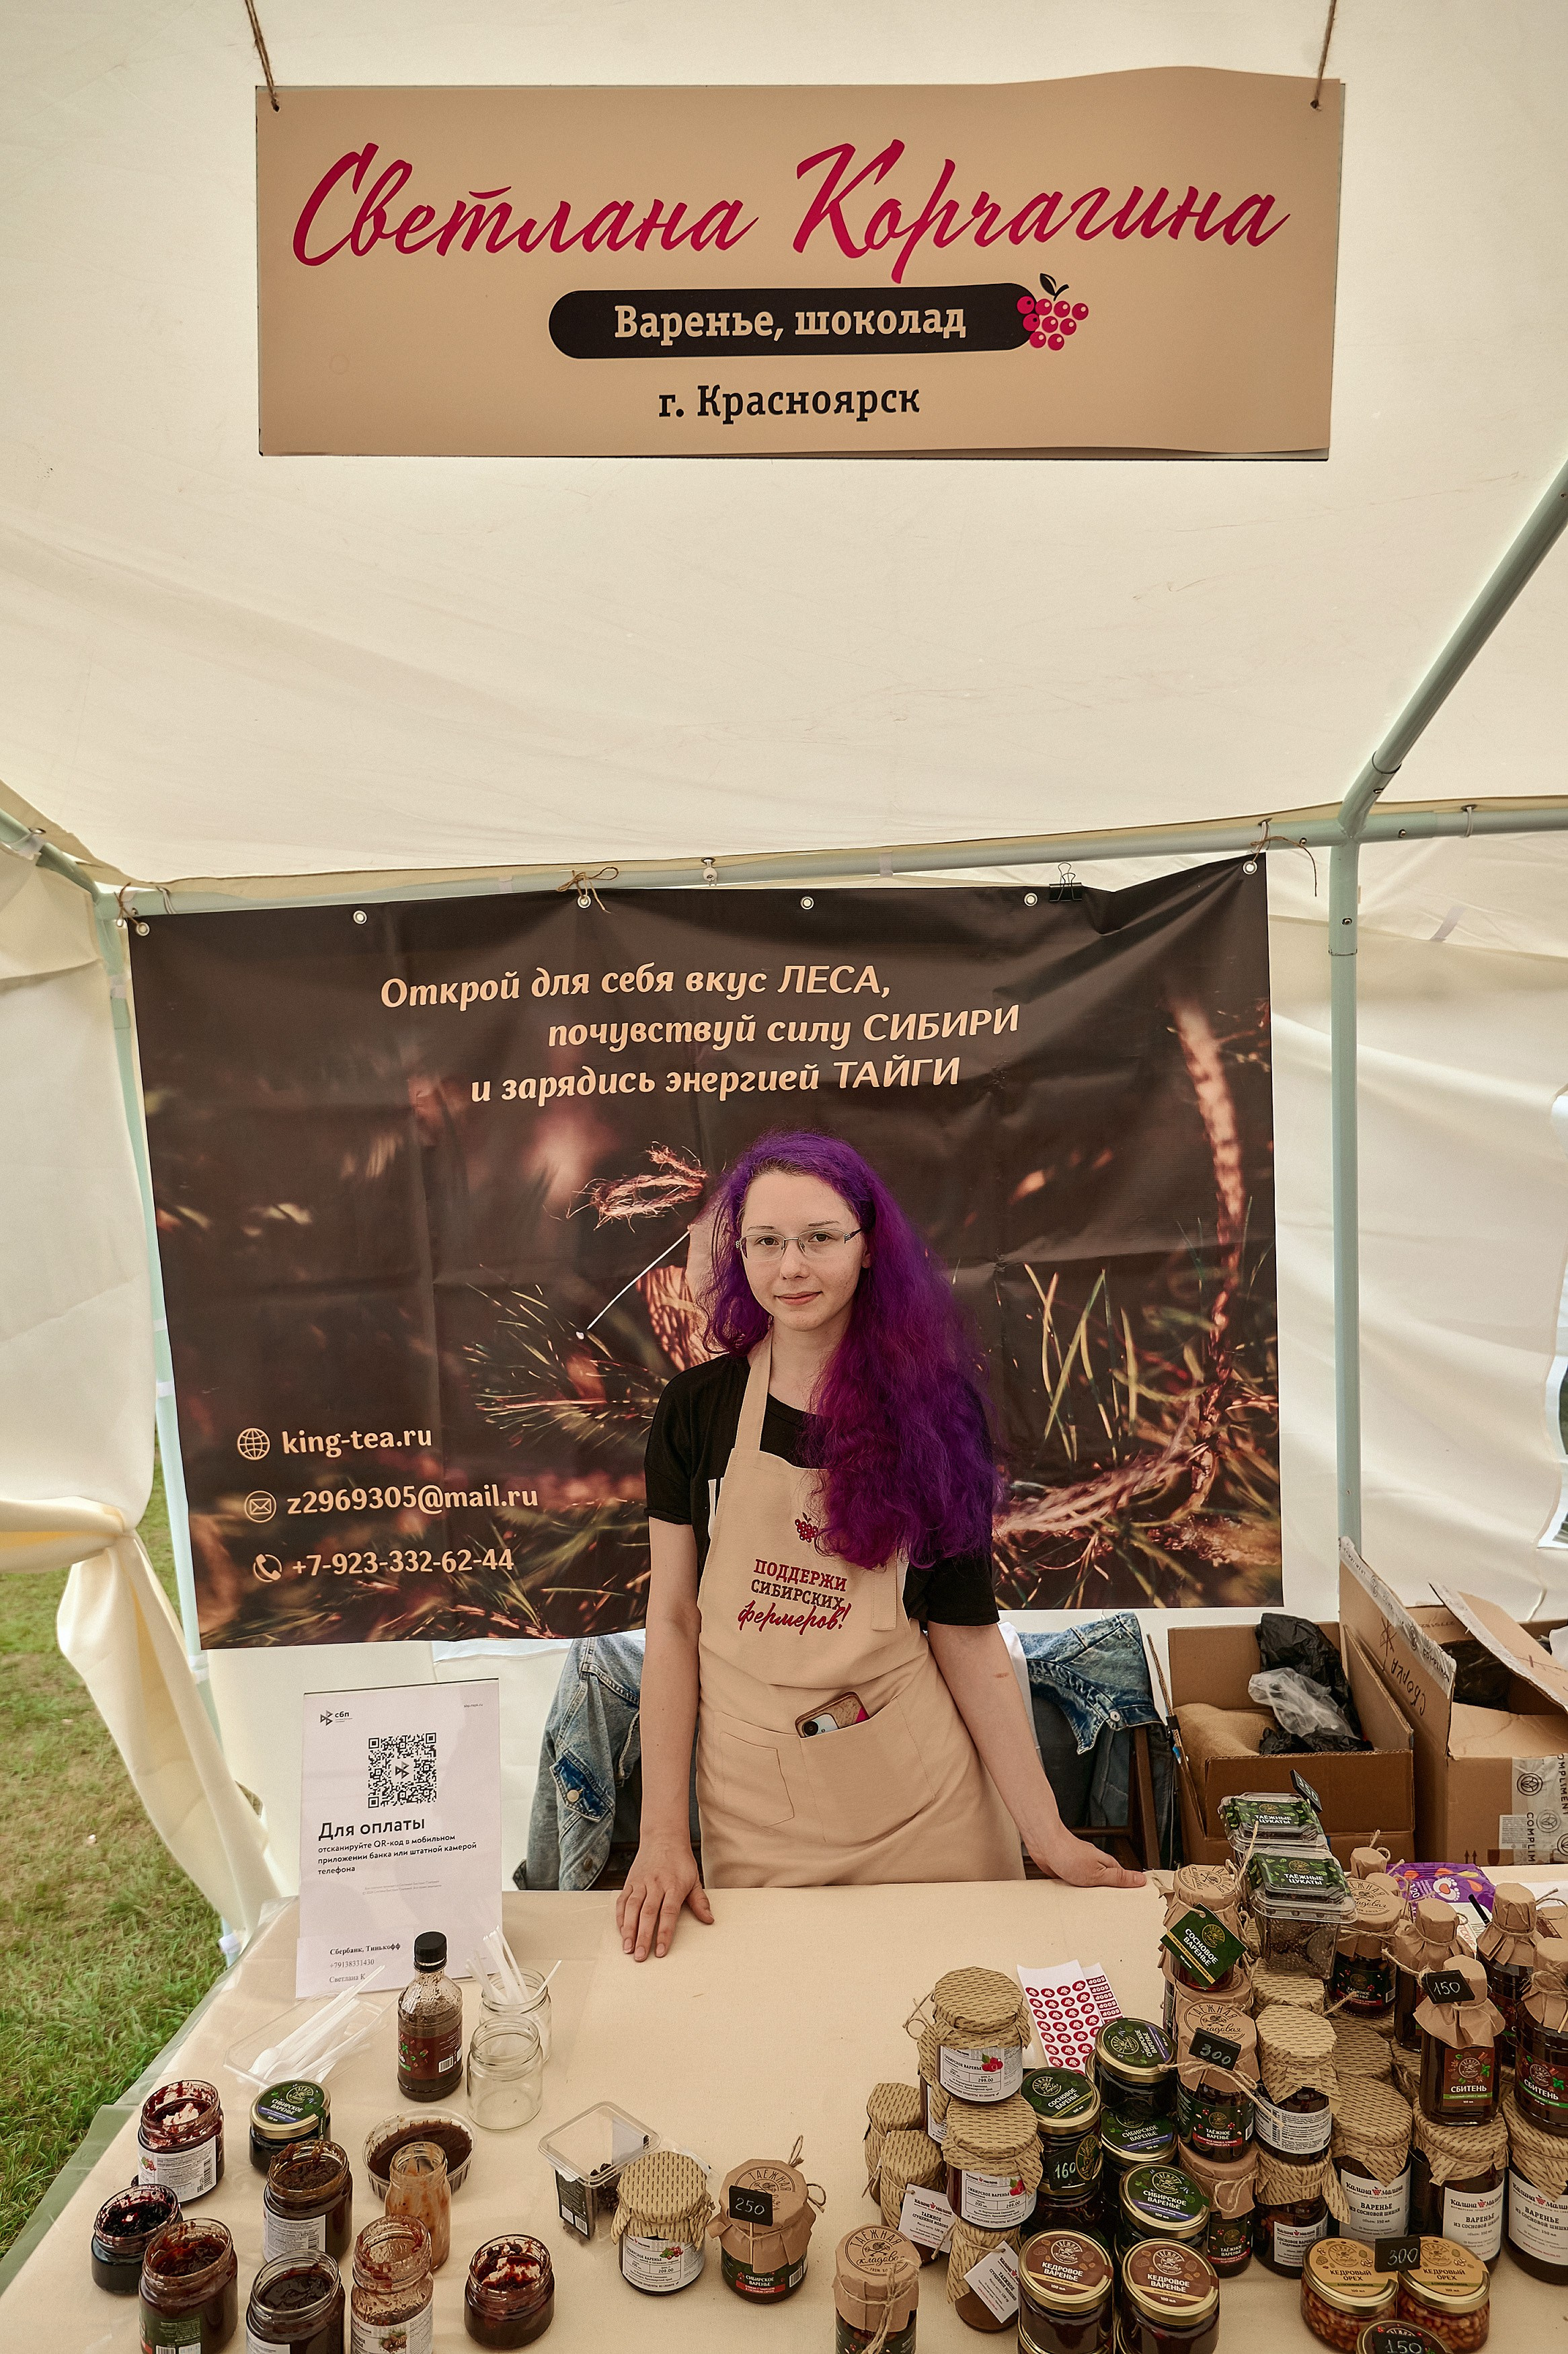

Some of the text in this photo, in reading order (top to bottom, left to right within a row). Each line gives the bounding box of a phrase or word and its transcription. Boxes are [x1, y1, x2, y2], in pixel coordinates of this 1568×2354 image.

[292, 139, 1292, 284] Светлана Корчагина
[613, 303, 967, 344] Варенье, шоколад
[658, 385, 921, 423] г. Красноярск
[381, 964, 890, 1012] Открой для себя вкус ЛЕСА,
[549, 1004, 1021, 1049] почувствуй силу СИБИРИ
[470, 1055, 961, 1107] и зарядись энергией ТАЙГИ
[282, 1429, 432, 1458] king-tea.ru
[287, 1484, 538, 1514] z2969305@mail.ru
[292, 1549, 514, 1577] +7-923-332-62-44
[753, 1559, 847, 1592] ПОДДЕРЖИ
[750, 1579, 845, 1609] СИБИРСКИХ
[738, 1600, 851, 1636] фермеров!
[318, 1819, 425, 1842] Для оплаты
[1526, 1813, 1536, 1864] COMPLIM
[318, 1842, 372, 1854] отсканируйте
[374, 1839, 404, 1848] QR-код
[411, 1835, 455, 1844] мобильном
[318, 1854, 368, 1865] приложении
[369, 1850, 392, 1859] банка
[409, 1846, 442, 1855] штатной
[444, 1842, 477, 1852] камерой
[318, 1865, 356, 1875] телефона
[366, 1942, 401, 1952] Тинькофф
[1183, 1936, 1212, 1967] ВАРЕНЬЕ
[1185, 1928, 1218, 1964] СОСНОВОЕ
[329, 1974, 358, 1983] Светлана
[1434, 1981, 1460, 1995] 150
[1188, 2004, 1239, 2019] ТАЕЖНАЯ
[1204, 2023, 1242, 2035] ладовая
[1200, 2043, 1231, 2064] 300
[1451, 2085, 1487, 2093] СБИТЕНЬ
[1524, 2079, 1559, 2100] СБИТЕНЬ
[272, 2099, 304, 2113] СИБИРСКОЕ
[1048, 2088, 1077, 2108] СОСНОВОЕ
[1054, 2092, 1080, 2110] ВАРЕНЬЕ
[270, 2104, 296, 2115] ВАРЕНЬЕ
[1122, 2124, 1159, 2139] СИБИРСКОЕ
[1129, 2130, 1159, 2141] ВАРЕНЬЕ
[1054, 2162, 1076, 2179] 160
[748, 2169, 792, 2191] ТАЕЖНАЯ
[1346, 2182, 1372, 2195] Калина
[736, 2197, 765, 2215] 250
[1143, 2190, 1187, 2206] СИБИРСКОЕ
[1147, 2197, 1181, 2210] ВАРЕНЬЕ
[1450, 2199, 1477, 2208] Калина
[1466, 2213, 1495, 2222] ВАРЕНЬЕ
[1522, 2212, 1548, 2228] СОСНОВОЙ
[1525, 2207, 1559, 2224] ВАРЕНЬЕ
[850, 2230, 902, 2246] ТАЕЖНАЯ
[1387, 2248, 1418, 2266] 300
[1042, 2262, 1084, 2277] КЕДРОВОЕ
[1044, 2268, 1079, 2282] ВАРЕНЬЕ
[1147, 2274, 1190, 2287] КЕДРОВОЕ
[1150, 2280, 1187, 2293] ВАРЕНЬЕ
[1386, 2339, 1422, 2354] 150
